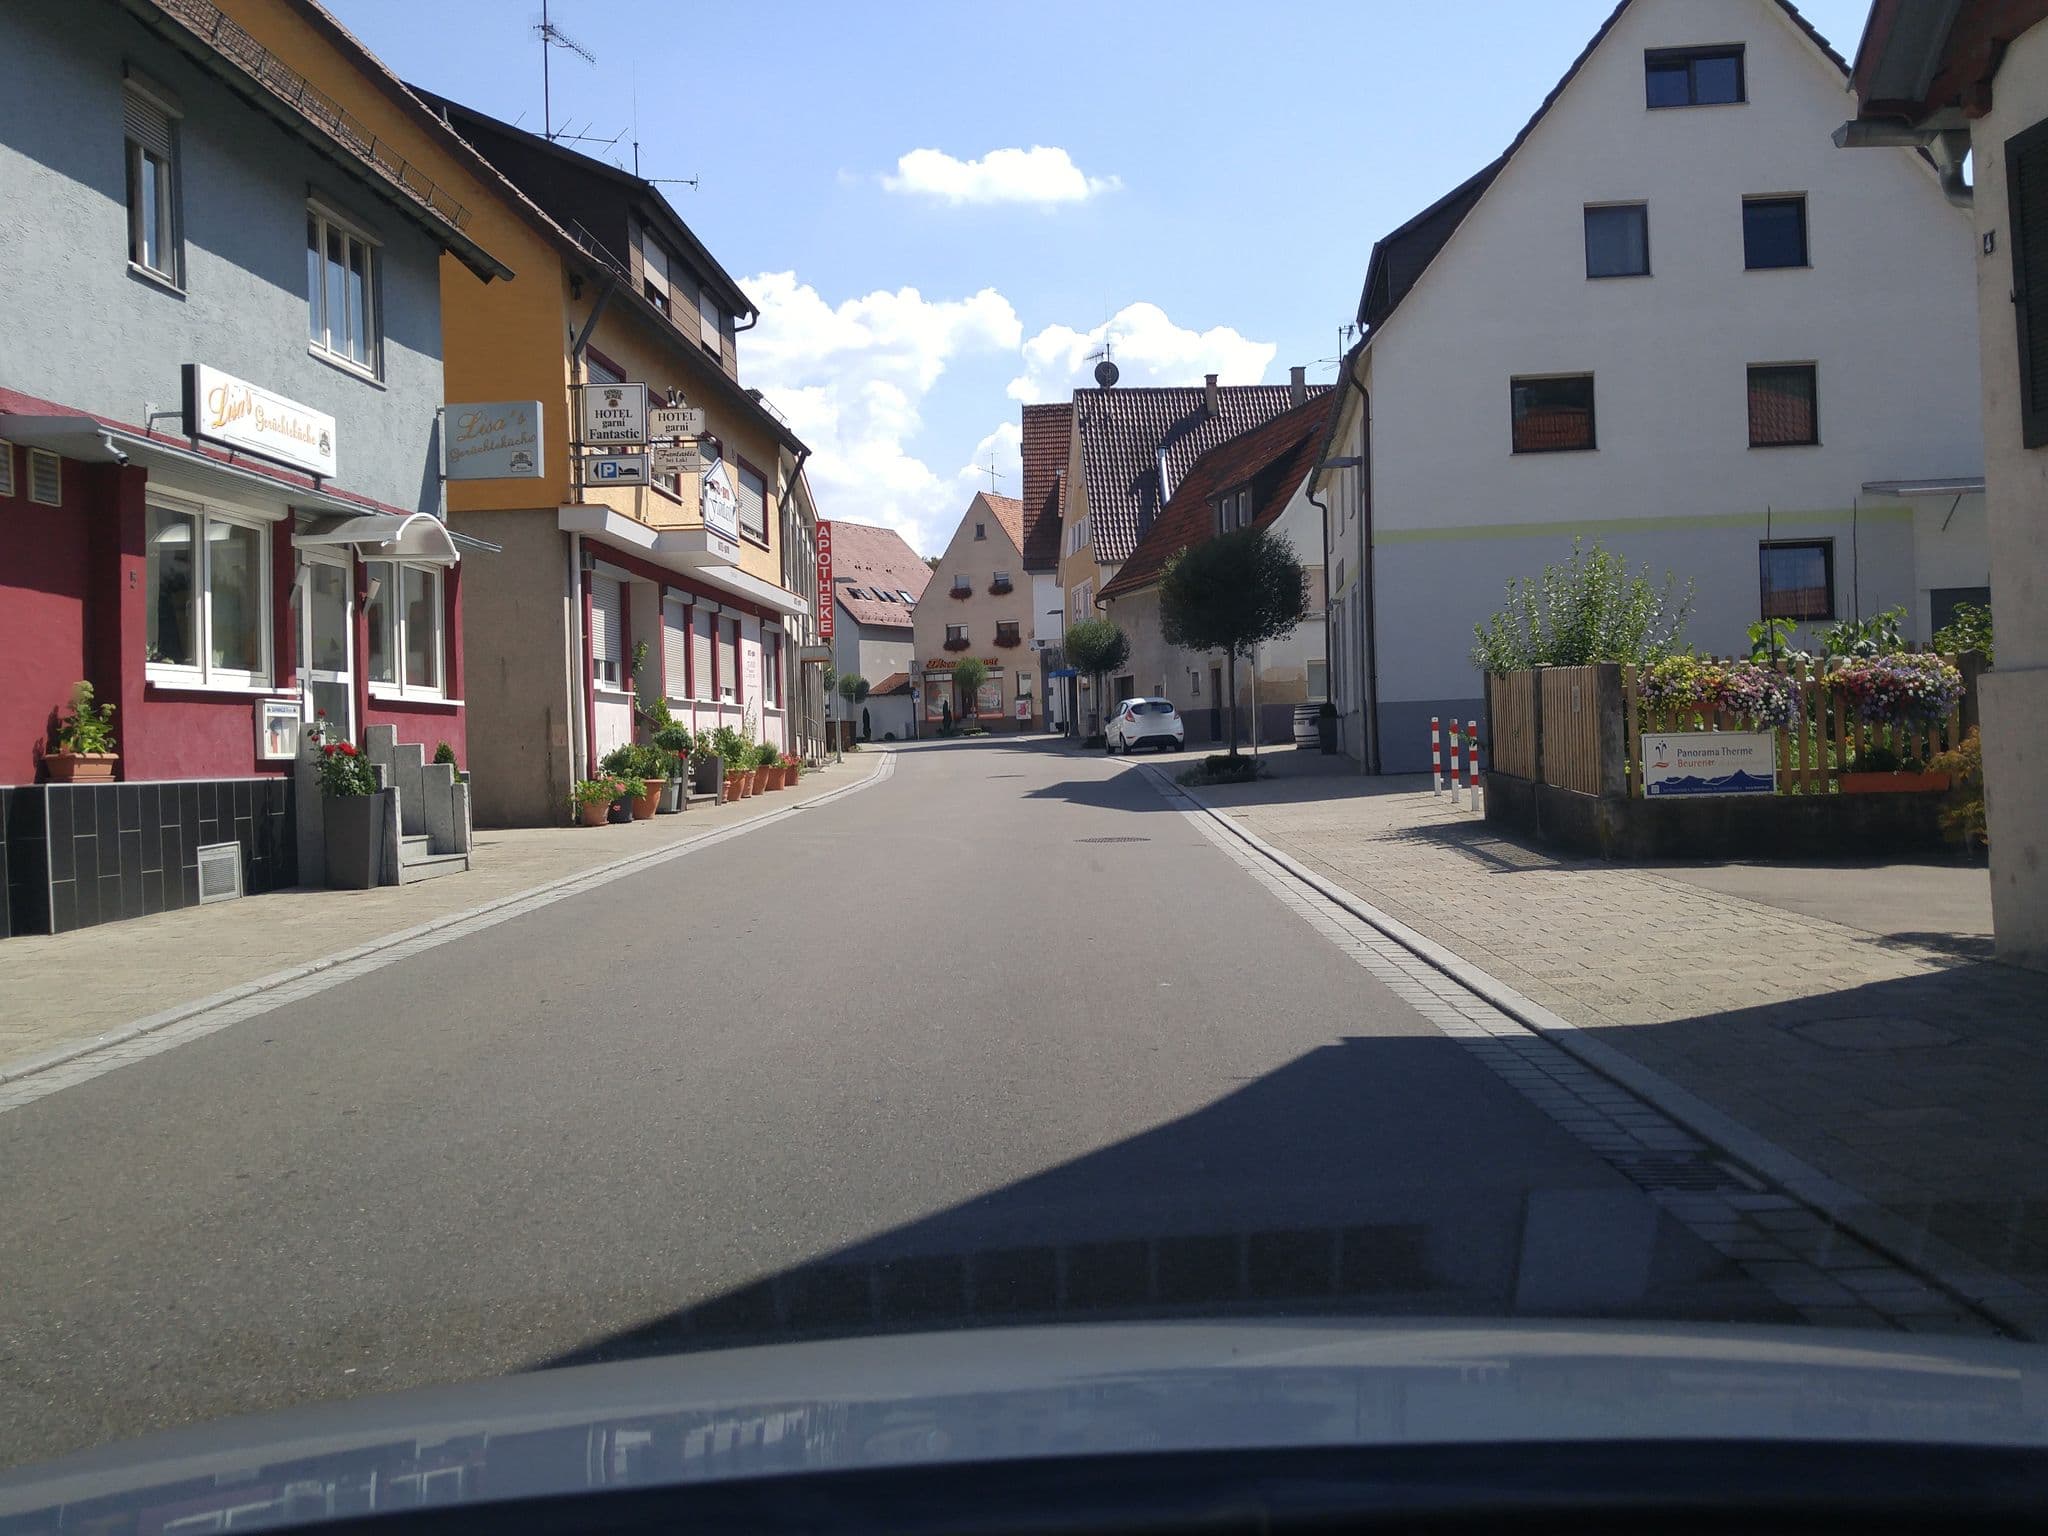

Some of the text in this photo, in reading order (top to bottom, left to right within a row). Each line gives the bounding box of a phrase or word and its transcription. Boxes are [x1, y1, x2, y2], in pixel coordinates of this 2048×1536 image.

[595, 409, 633, 419] HOTEL
[658, 412, 697, 422] HOTEL
[602, 417, 626, 428] garni
[665, 422, 690, 433] garni
[589, 428, 640, 440] Fantastic
[657, 449, 697, 460] Fantastic
[817, 525, 832, 634] APOTHEKE
[1677, 746, 1753, 757] Panorama Therme
